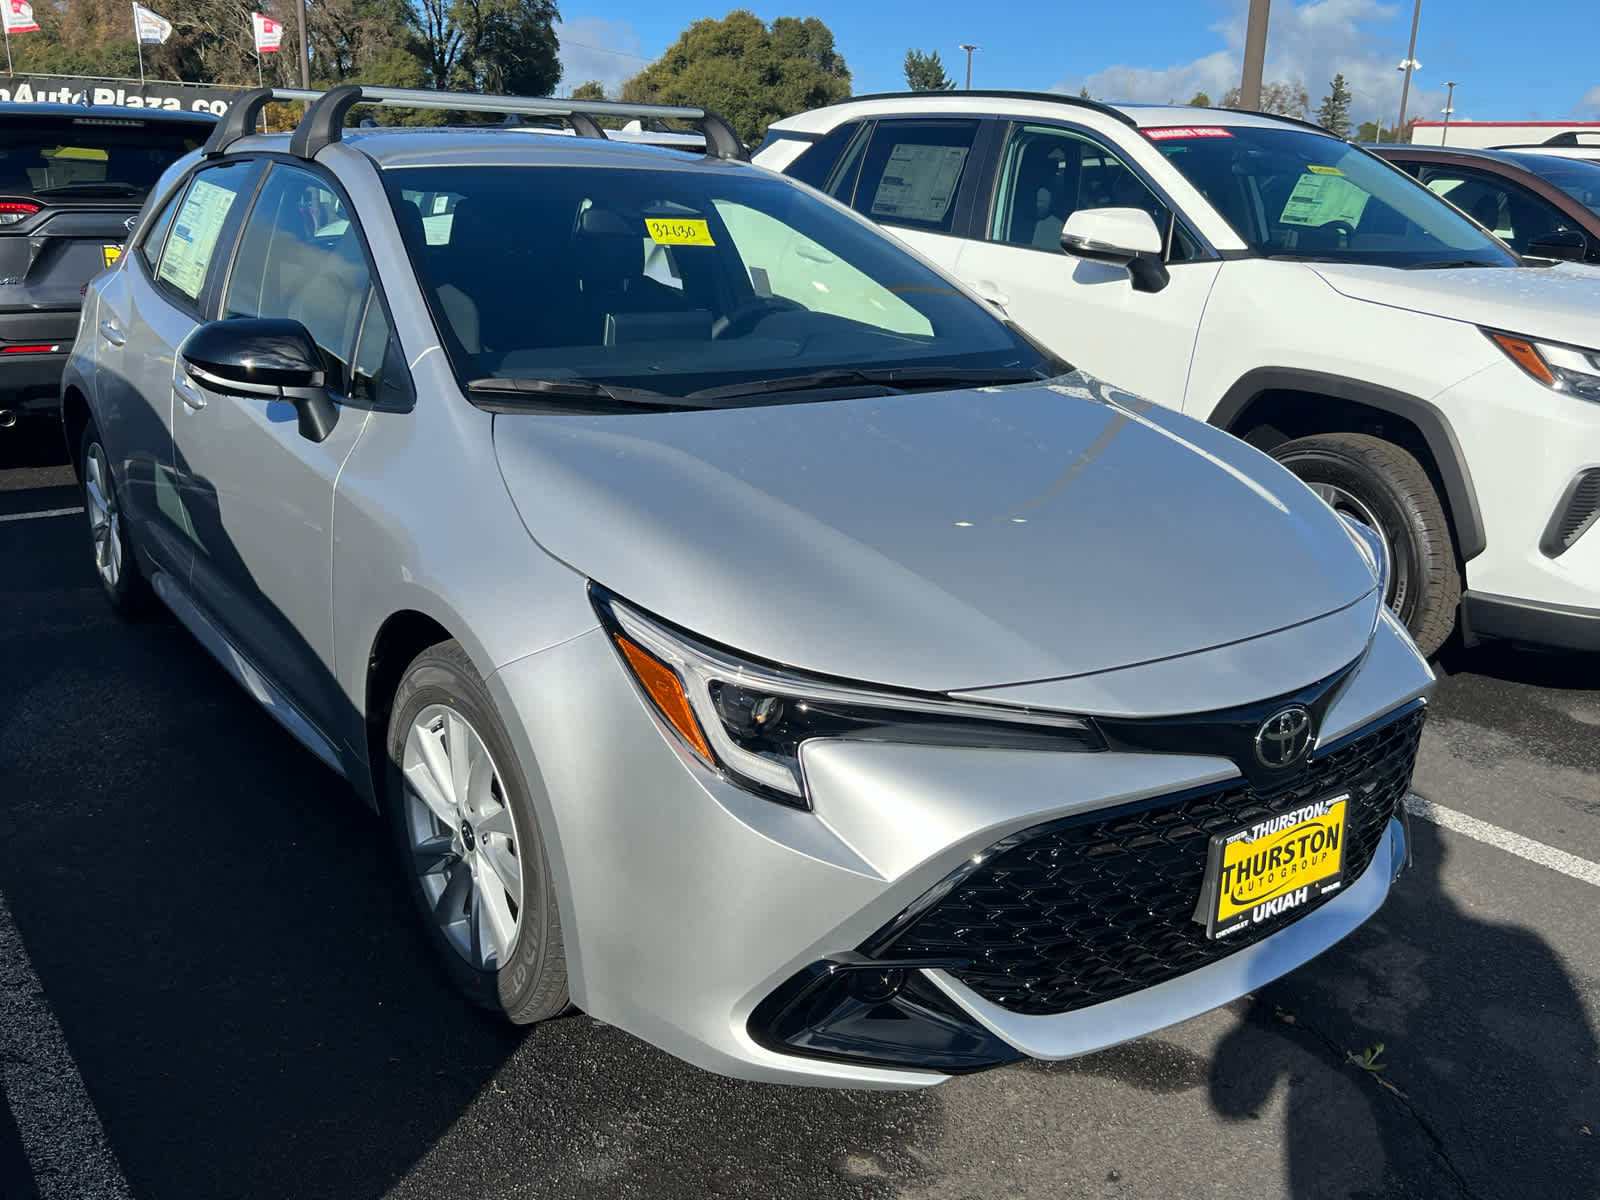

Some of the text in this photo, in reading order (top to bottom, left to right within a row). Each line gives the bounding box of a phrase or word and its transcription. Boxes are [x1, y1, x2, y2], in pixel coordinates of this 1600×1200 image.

[1251, 801, 1325, 840] THURSTON
[1222, 822, 1340, 895] THURSTON
[1252, 886, 1308, 923] UKIAH
